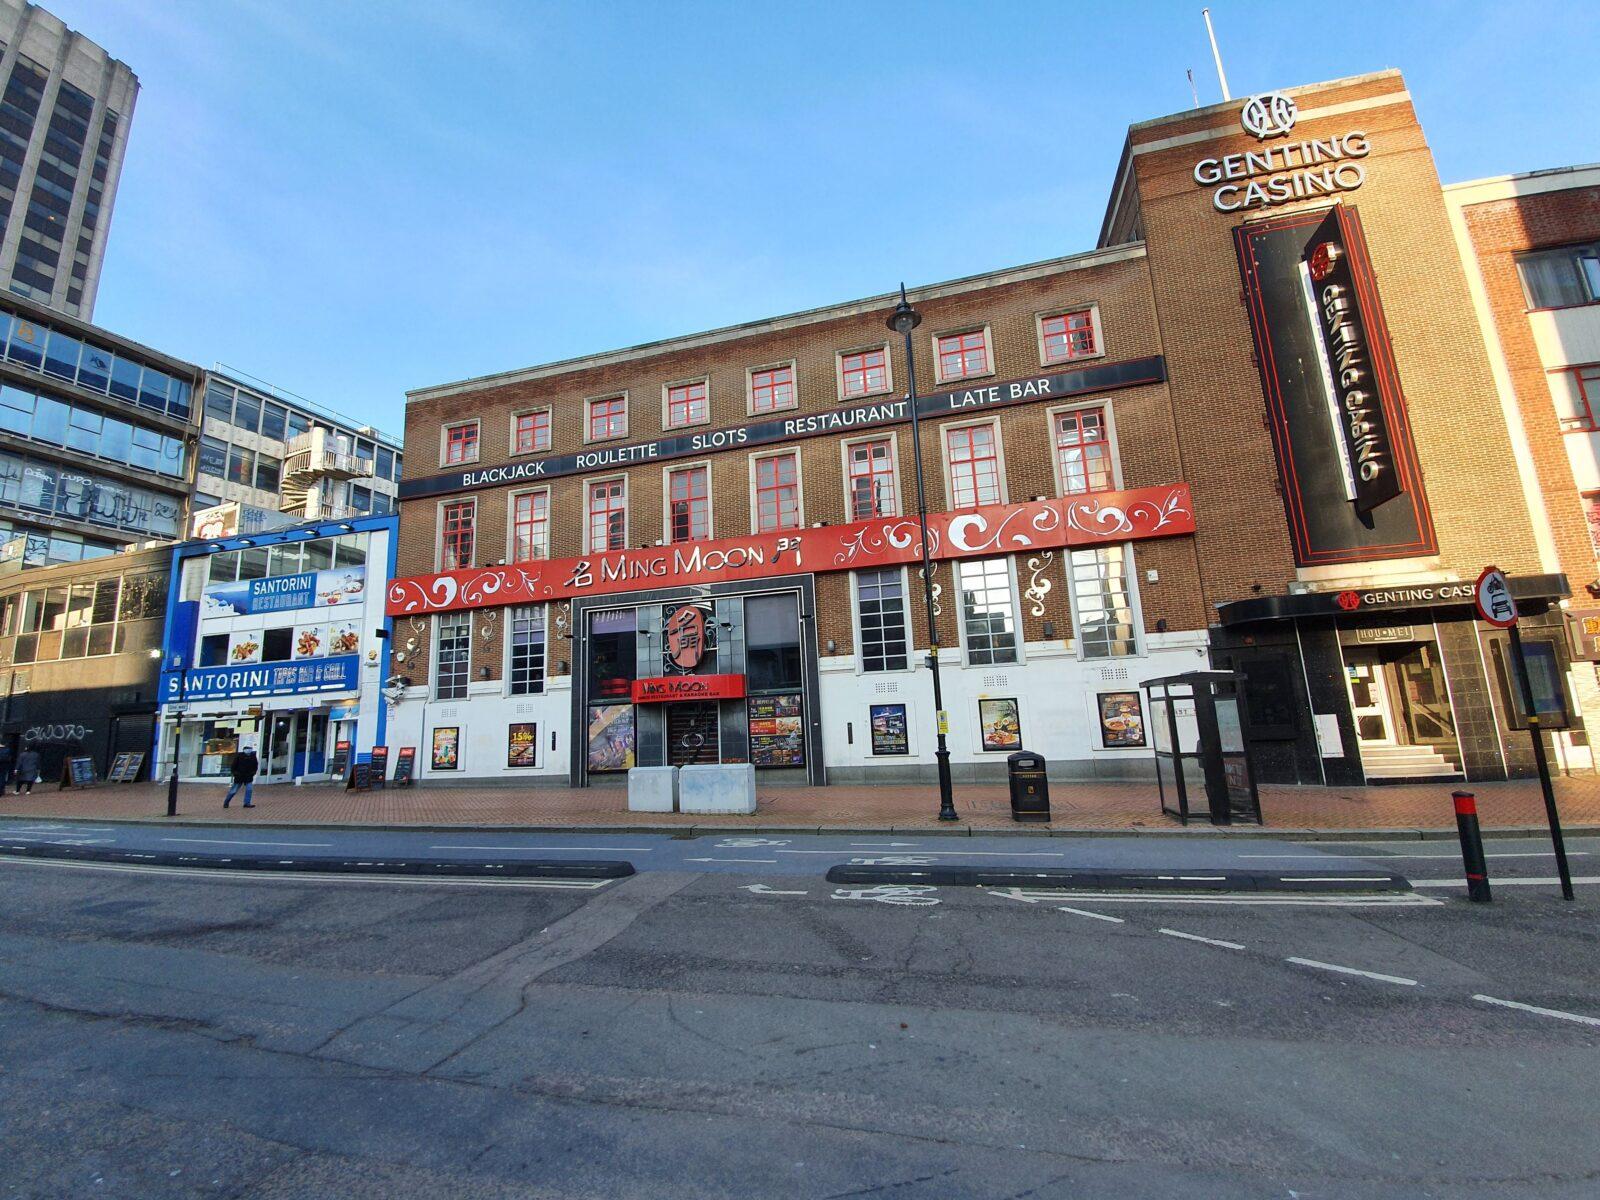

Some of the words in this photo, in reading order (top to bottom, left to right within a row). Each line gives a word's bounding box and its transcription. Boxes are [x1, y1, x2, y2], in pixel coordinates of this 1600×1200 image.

[1194, 130, 1372, 185] GENTING
[1213, 162, 1365, 213] CASINO
[1322, 284, 1360, 388] GENTING
[949, 386, 1001, 409] LATE
[1010, 378, 1051, 399] BAR
[784, 400, 908, 436] RESTAURANT
[691, 428, 748, 450] SLOTS
[1345, 391, 1379, 483] CASINO
[576, 442, 658, 469] ROULETTE
[462, 461, 545, 487] BLACKJACK
[254, 576, 312, 595] SANTORINI
[564, 560, 593, 587] 名
[252, 592, 310, 611] RESTAURANT
[1364, 587, 1434, 606] GENTING
[1440, 584, 1476, 600] CASI
[273, 666, 297, 685] TAPAS
[298, 665, 314, 684] BAR
[324, 662, 346, 681] GRILL
[512, 732, 533, 741] 15%
